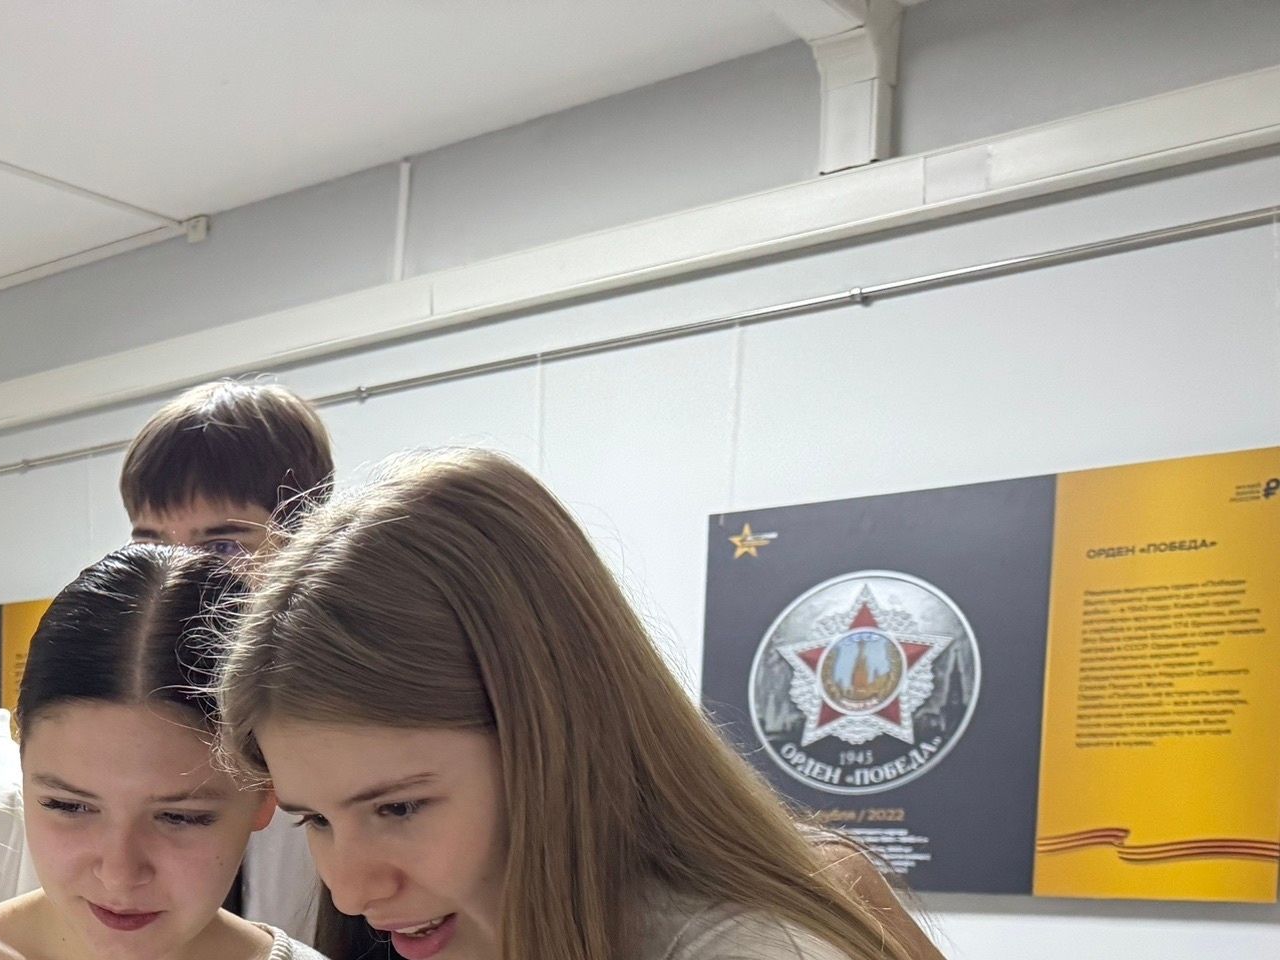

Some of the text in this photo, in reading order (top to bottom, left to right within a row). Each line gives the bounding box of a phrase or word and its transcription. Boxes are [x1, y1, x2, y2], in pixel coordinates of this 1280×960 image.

[1086, 539, 1218, 559] ОРДЕН «ПОБЕДА»
[780, 736, 942, 785] ОРДЕН «ПОБЕДА»
